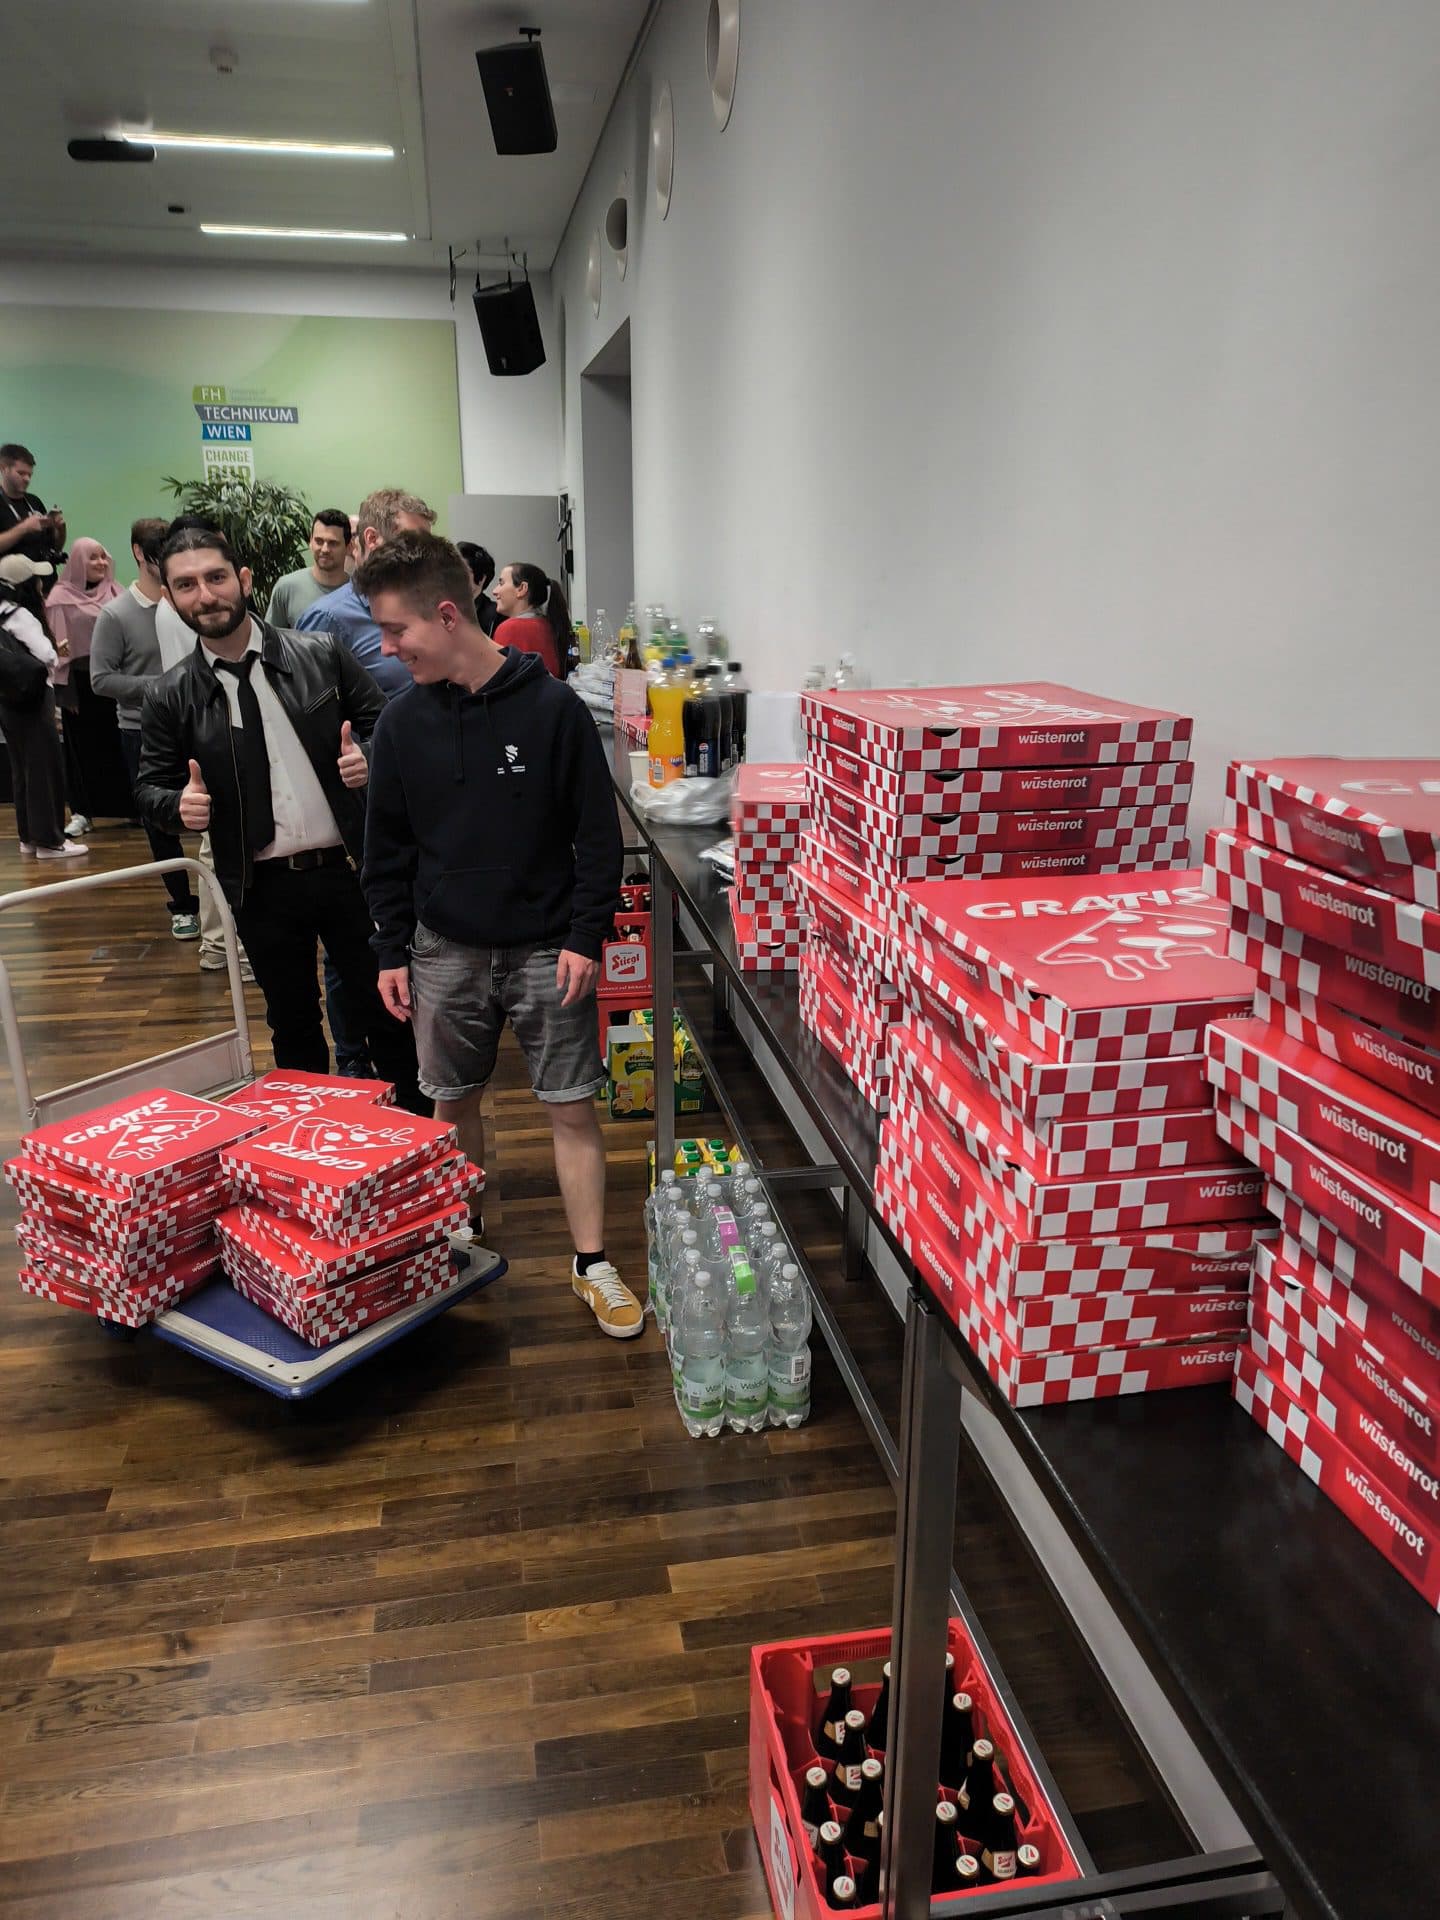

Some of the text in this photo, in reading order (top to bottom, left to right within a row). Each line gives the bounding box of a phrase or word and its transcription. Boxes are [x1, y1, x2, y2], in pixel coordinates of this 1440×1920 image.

[202, 388, 221, 401] FH
[204, 406, 293, 422] TECHNIKUM
[207, 425, 246, 439] WIEN
[206, 450, 249, 463] CHANGE
[1018, 730, 1085, 745] wüstenrot
[1021, 776, 1087, 790] wüstenrot
[1017, 819, 1083, 833] wüstenrot
[1021, 855, 1086, 870] wüstenrot
[965, 886, 1210, 920] GRATIS
[1297, 883, 1376, 928] wüstenrot
[1352, 1030, 1434, 1086] wüstenrot
[263, 1081, 371, 1099] GRATIS
[62, 1097, 168, 1145] GRATIS
[1318, 1103, 1407, 1165] wüstenrot
[252, 1142, 368, 1170] GRATIS
[1200, 1180, 1263, 1198] wüsten
[1308, 1163, 1383, 1231] wüstenrot
[1191, 1261, 1252, 1272] wüste
[1189, 1299, 1248, 1313] wüste
[1180, 1350, 1237, 1366] wüste
[1355, 1353, 1431, 1436] wüstenrot
[1359, 1413, 1440, 1501] wüstenrot
[1345, 1466, 1424, 1556] wüstenrot
